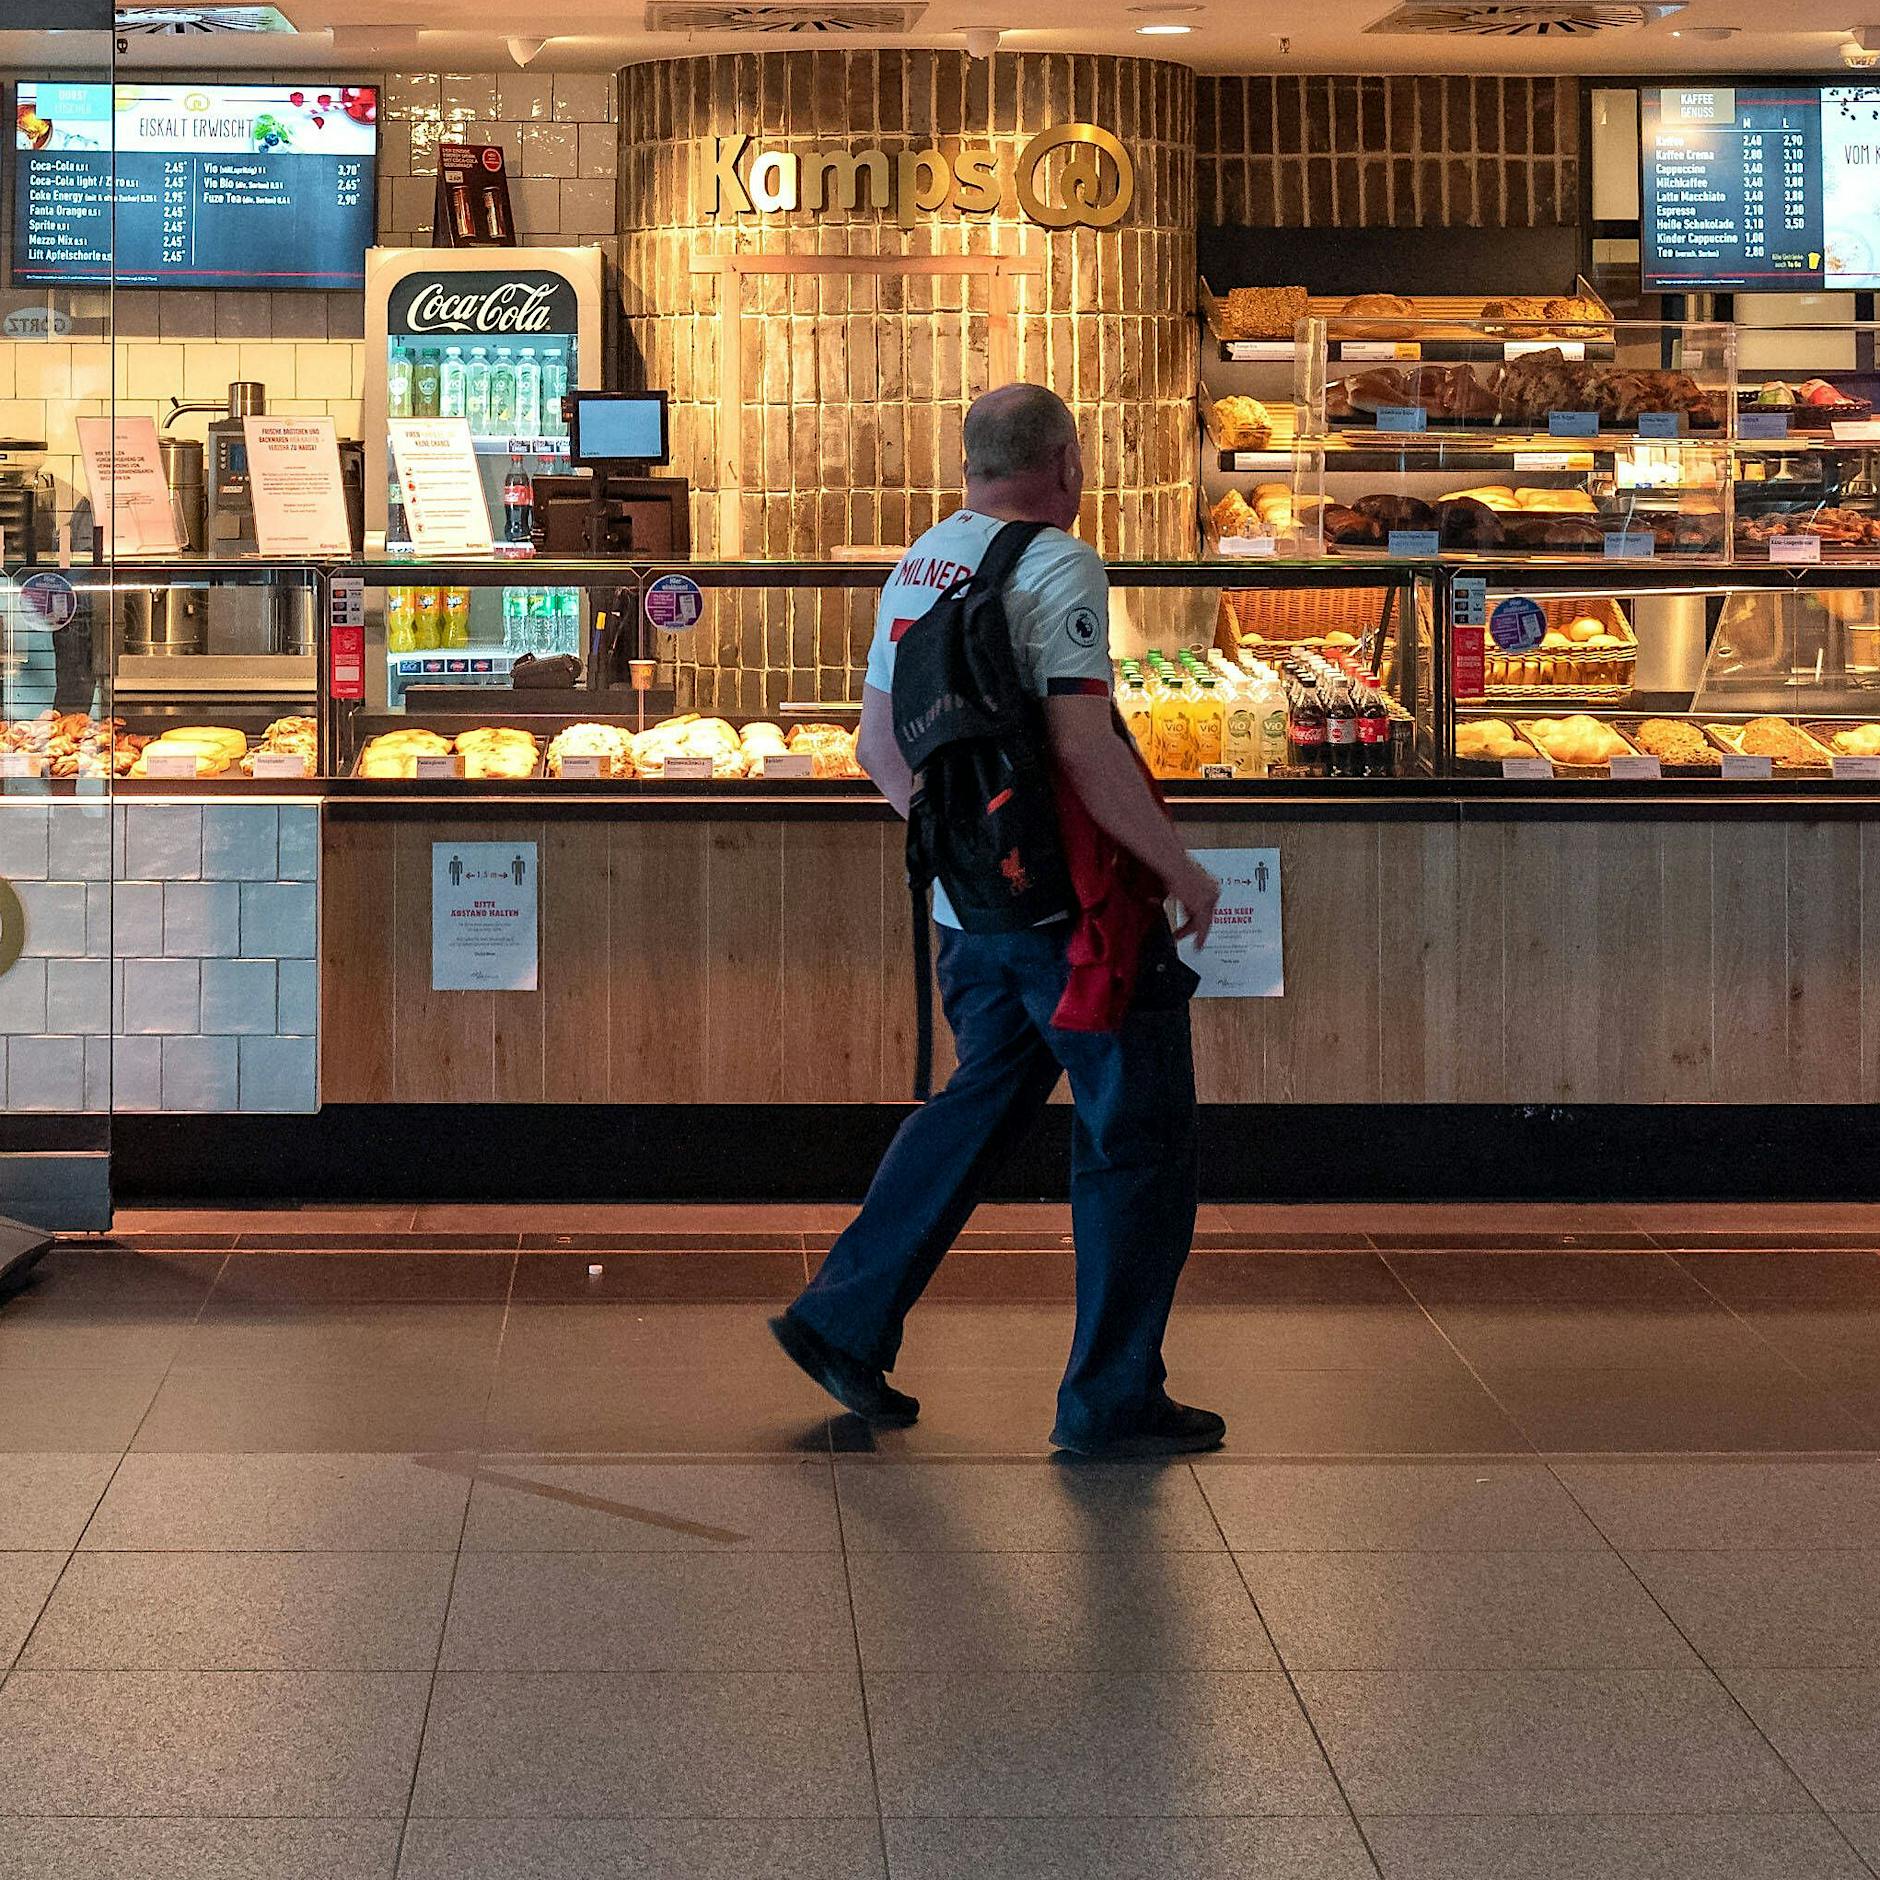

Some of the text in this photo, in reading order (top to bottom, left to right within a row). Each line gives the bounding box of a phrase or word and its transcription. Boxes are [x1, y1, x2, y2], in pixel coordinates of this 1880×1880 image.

[1680, 93, 1714, 105] KAFFEE
[1680, 106, 1714, 118] GENUSS
[139, 117, 254, 138] EISKALT ERWISCHT
[1782, 118, 1790, 129] L
[1655, 149, 1684, 161] Kaffee
[1686, 150, 1714, 160] Crema
[1844, 144, 1870, 164] VOM
[30, 160, 74, 171] Coca-Cola
[203, 162, 218, 174] Vio
[1655, 163, 1706, 176] Cappuccino
[30, 174, 74, 186] Coca-Cola
[77, 175, 97, 189] light
[203, 177, 218, 189] Vio
[219, 177, 234, 189] Bio
[713, 133, 1002, 230] Kamps
[1655, 177, 1708, 188] Milchkaffee
[29, 189, 51, 202] Coke
[53, 190, 84, 204] Energy
[203, 191, 225, 204] Fuze
[225, 192, 241, 204] Tea
[1656, 190, 1680, 202] Latte
[1680, 190, 1726, 202] Macchiato
[29, 204, 54, 216] Fanta
[56, 205, 87, 219] Orange
[1656, 204, 1697, 218] Espresso
[28, 219, 56, 232] Sprite
[1656, 218, 1682, 230] Heiße
[1683, 219, 1735, 230] Schokolade
[1784, 218, 1805, 230] 3,50
[28, 234, 56, 246] Mezzo
[57, 234, 73, 246] Mix
[1656, 232, 1687, 244] Kinder
[1687, 232, 1739, 246] Cappuccino
[28, 248, 43, 261] Lift
[45, 249, 101, 262] Apfelschorle
[1656, 246, 1673, 258] Tee
[406, 282, 560, 332] Coca-Cola
[473, 901, 496, 909] BITTE
[1234, 907, 1254, 915] KEEP
[450, 909, 520, 917] ABSTAND HALTEN
